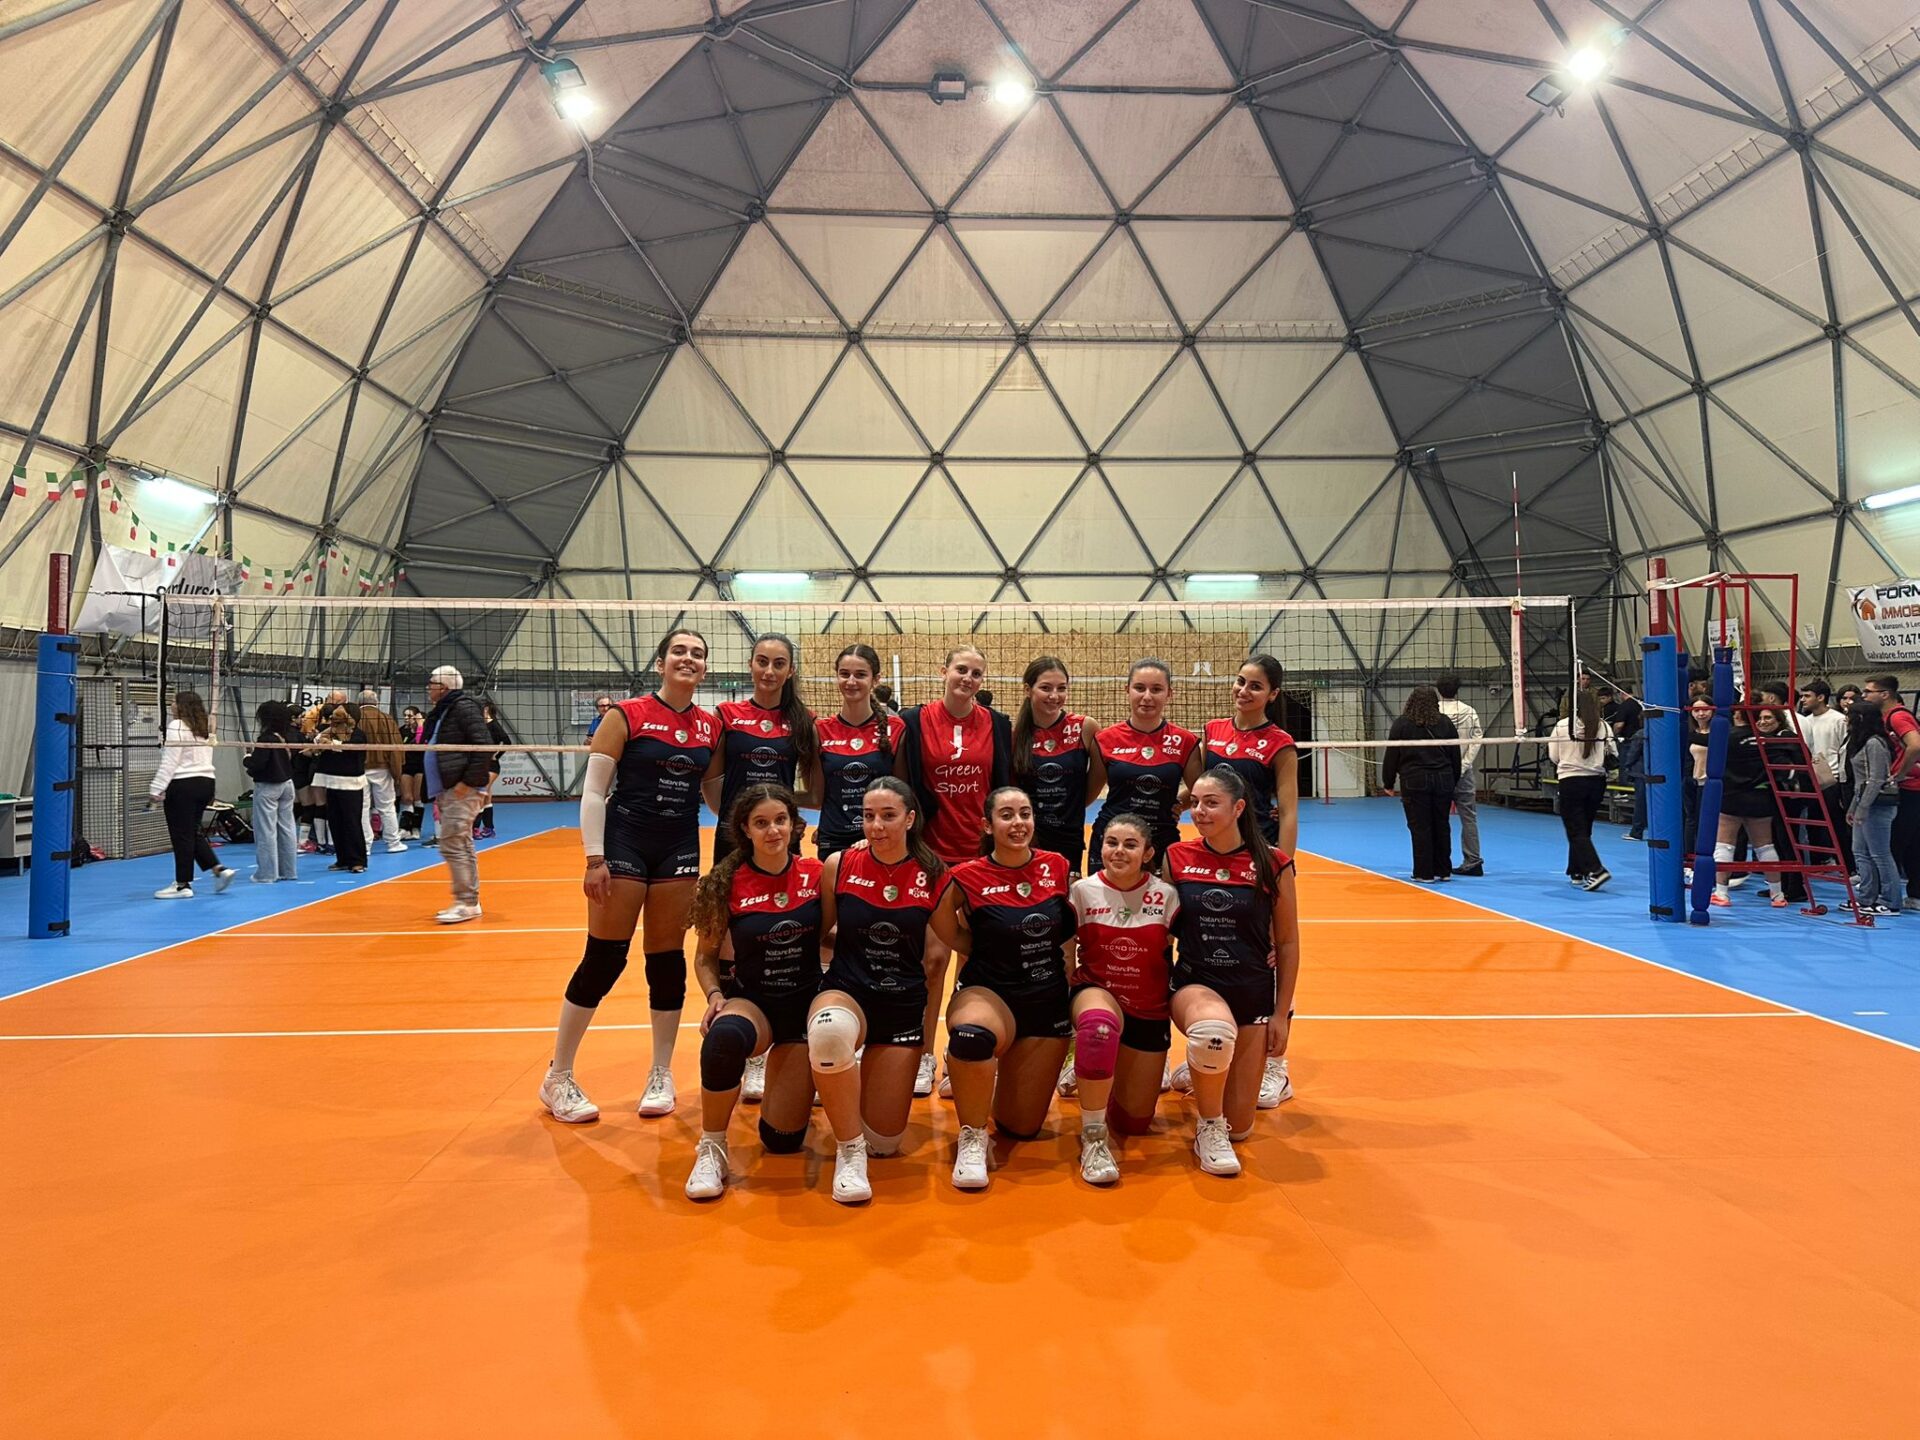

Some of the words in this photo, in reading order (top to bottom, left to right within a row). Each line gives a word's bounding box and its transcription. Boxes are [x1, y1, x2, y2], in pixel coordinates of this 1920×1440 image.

[1879, 635, 1897, 647] 338
[696, 719, 711, 734] 10
[1063, 722, 1082, 735] 44
[1162, 734, 1182, 746] 29
[1257, 739, 1268, 749] 9
[935, 764, 983, 778] Green
[934, 781, 980, 798] Sport
[1040, 863, 1051, 878] 2
[799, 873, 809, 887] 7
[915, 871, 927, 887] 8
[1142, 891, 1164, 906] 62
